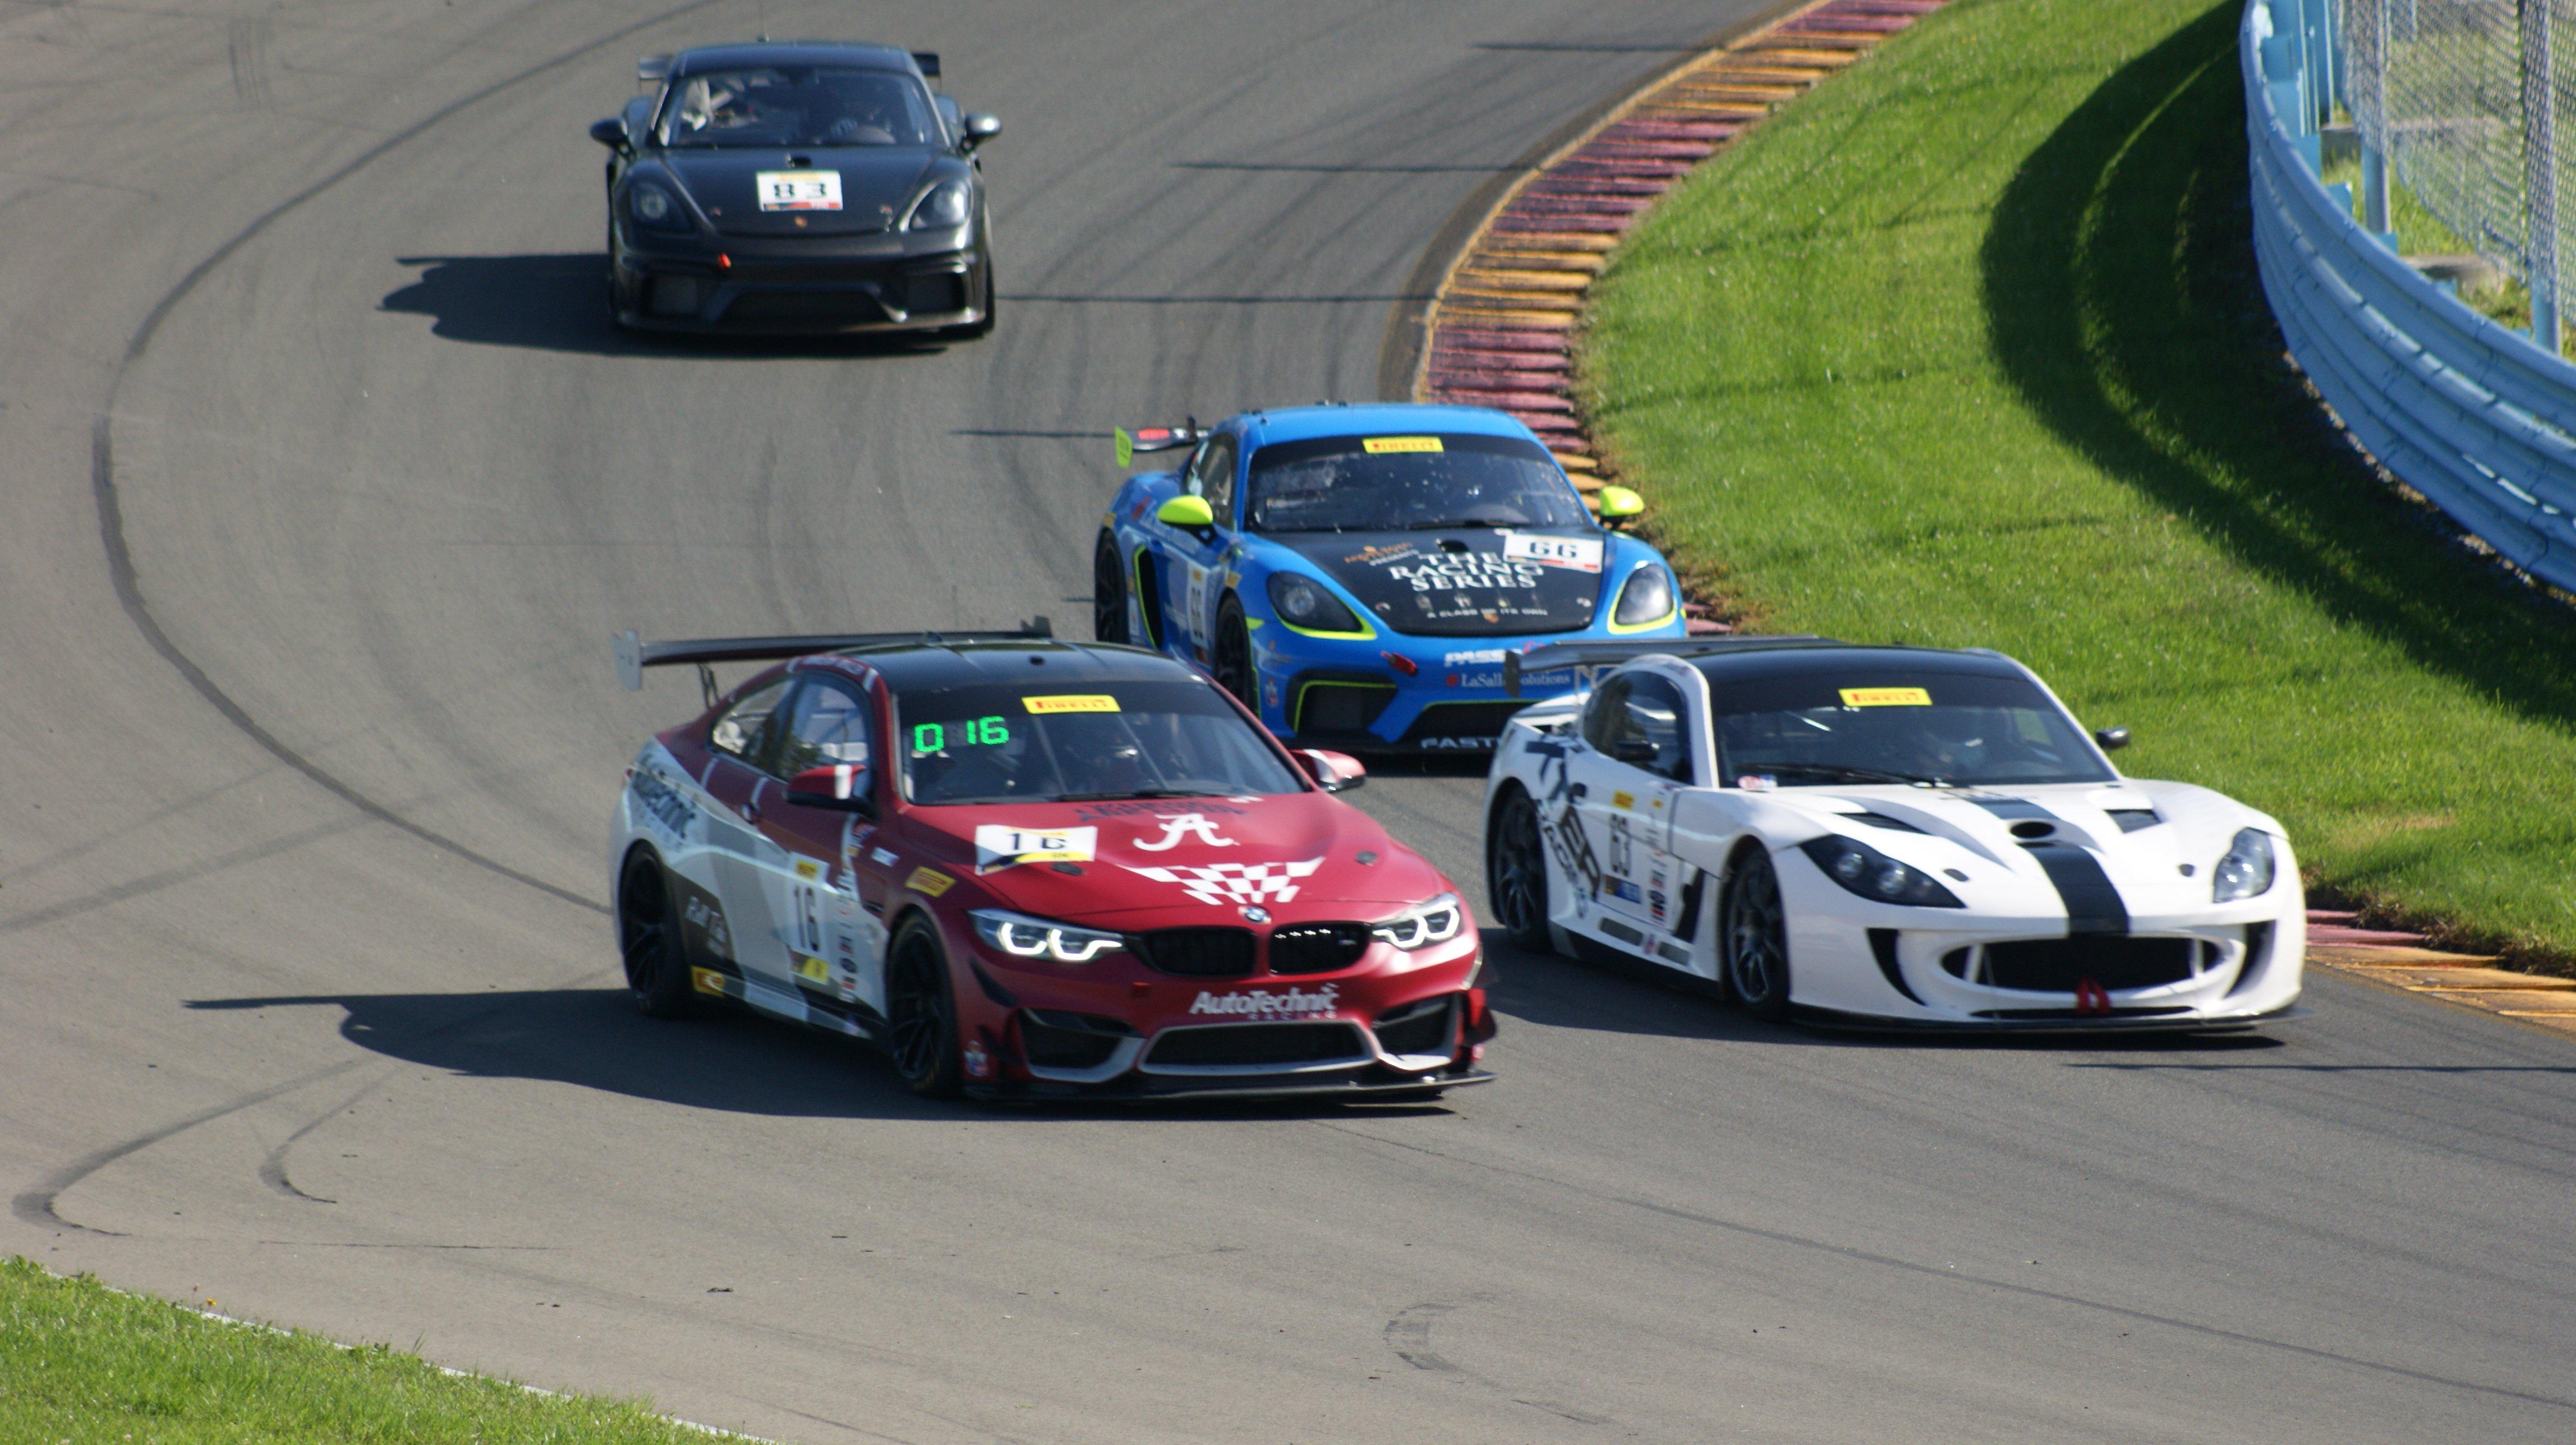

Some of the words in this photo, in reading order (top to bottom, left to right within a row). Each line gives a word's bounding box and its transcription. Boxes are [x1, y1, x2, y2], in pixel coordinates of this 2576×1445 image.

[774, 182, 826, 198] 83
[1419, 552, 1502, 565] THE
[1530, 540, 1577, 559] 66
[1390, 562, 1544, 580] RACING
[1411, 574, 1537, 592] SERIES
[1461, 674, 1506, 687] LaSall
[1519, 674, 1570, 687] olutions
[966, 715, 1009, 745] 16
[1421, 737, 1501, 749] FAST
[1008, 832, 1067, 851] 16
[794, 885, 820, 952] 16
[1189, 983, 1340, 1014] AutoTechnic
